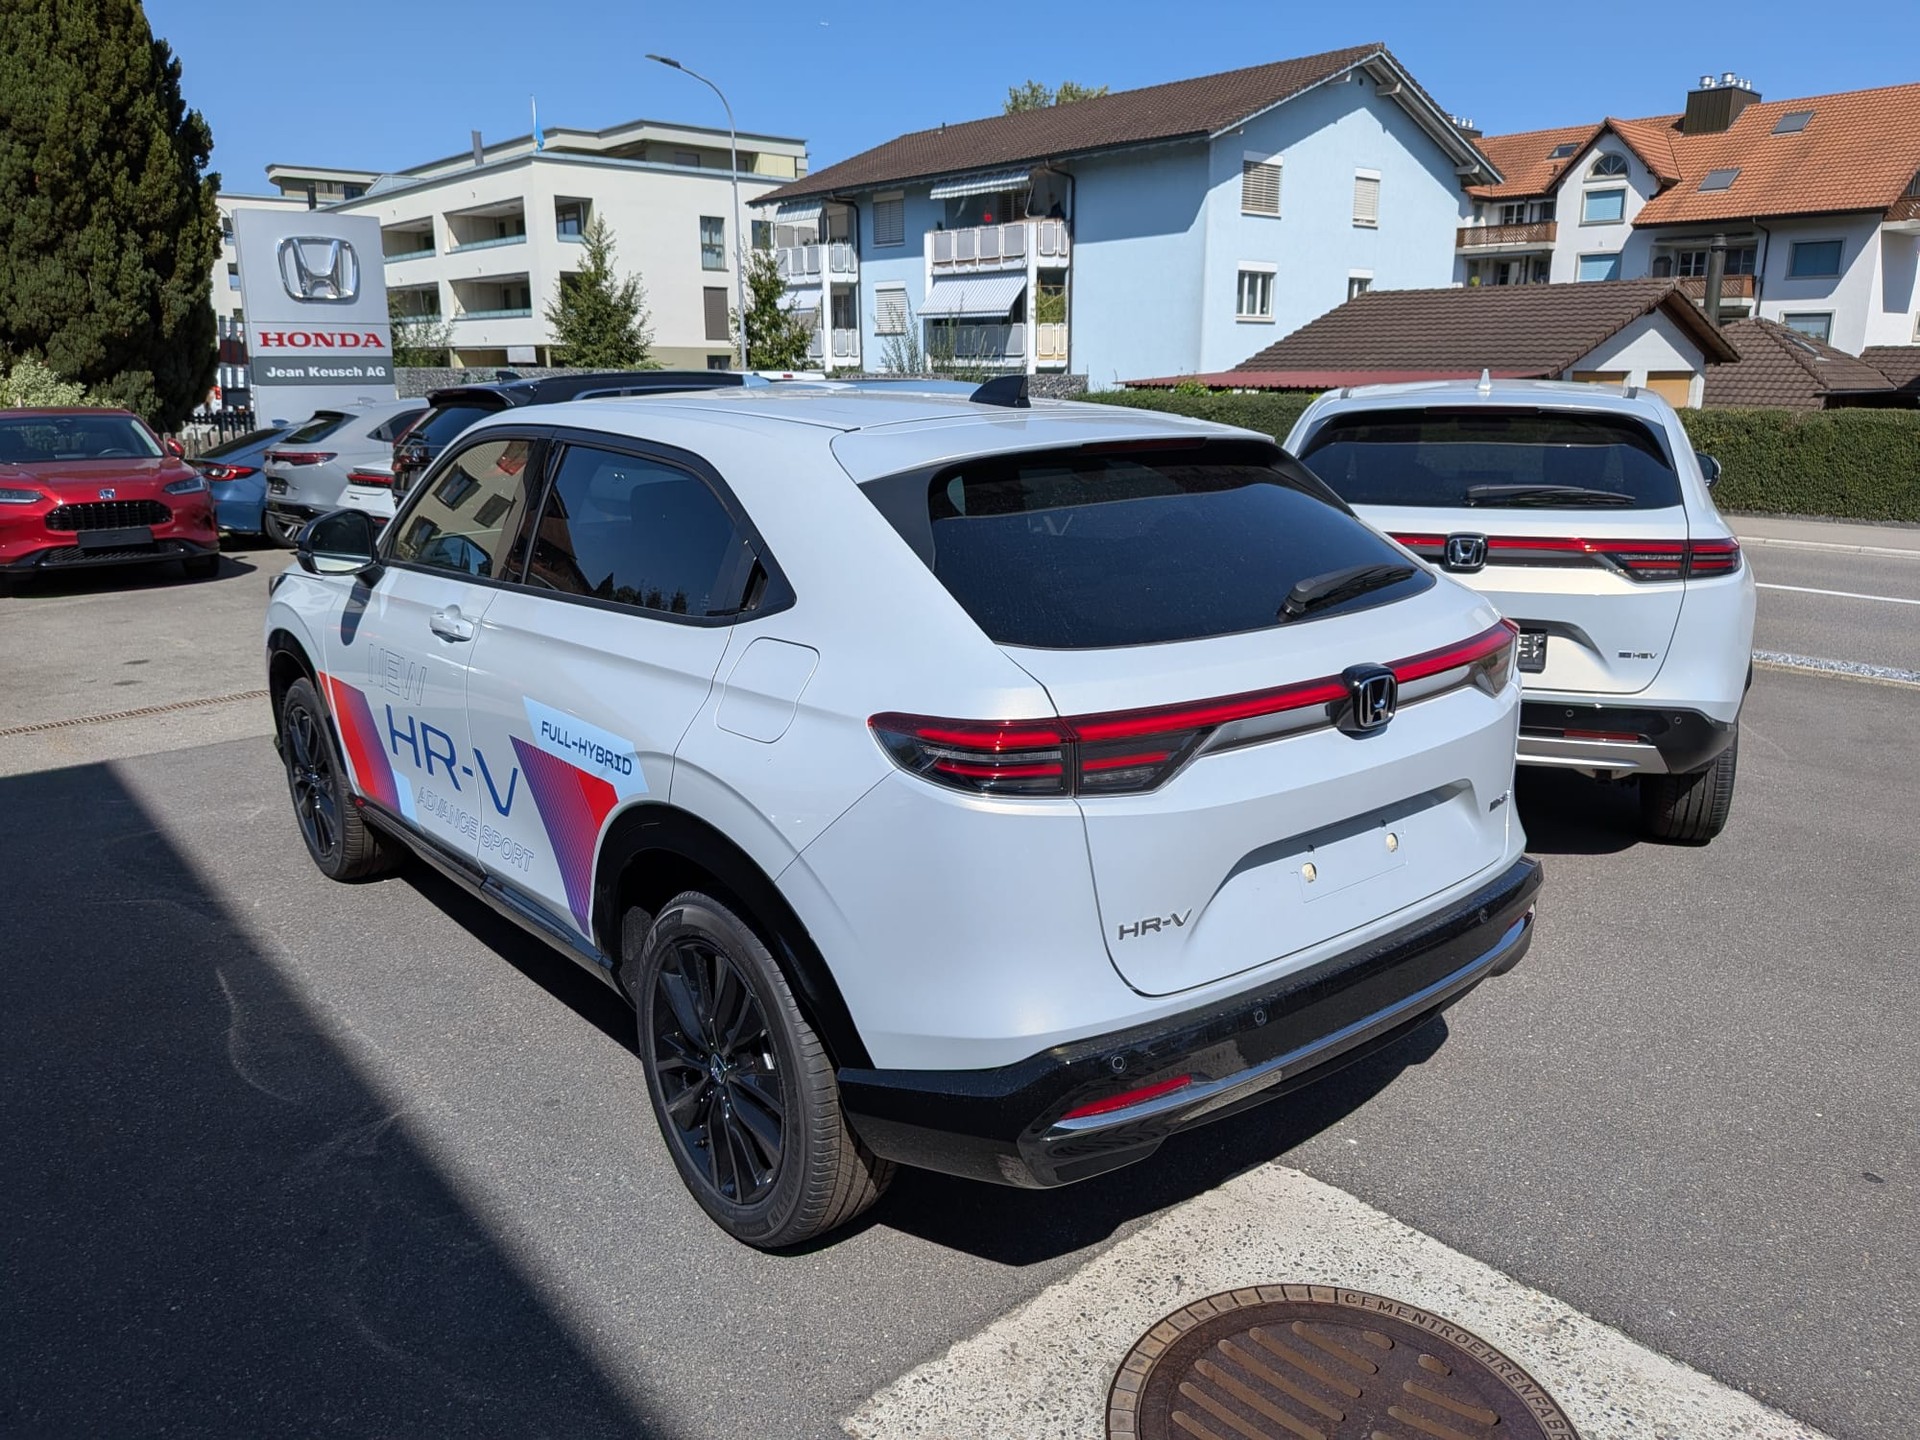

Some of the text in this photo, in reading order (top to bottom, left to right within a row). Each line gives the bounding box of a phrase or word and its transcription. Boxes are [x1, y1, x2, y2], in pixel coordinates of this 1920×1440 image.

[258, 332, 385, 348] HONDA
[266, 366, 386, 378] Jean Keusch AG
[368, 643, 428, 706] NEW
[385, 703, 519, 818] HR-V
[541, 720, 633, 776] FULL-HYBRID
[416, 786, 535, 872] ADVANCE SPORT
[1118, 908, 1192, 940] HR-V
